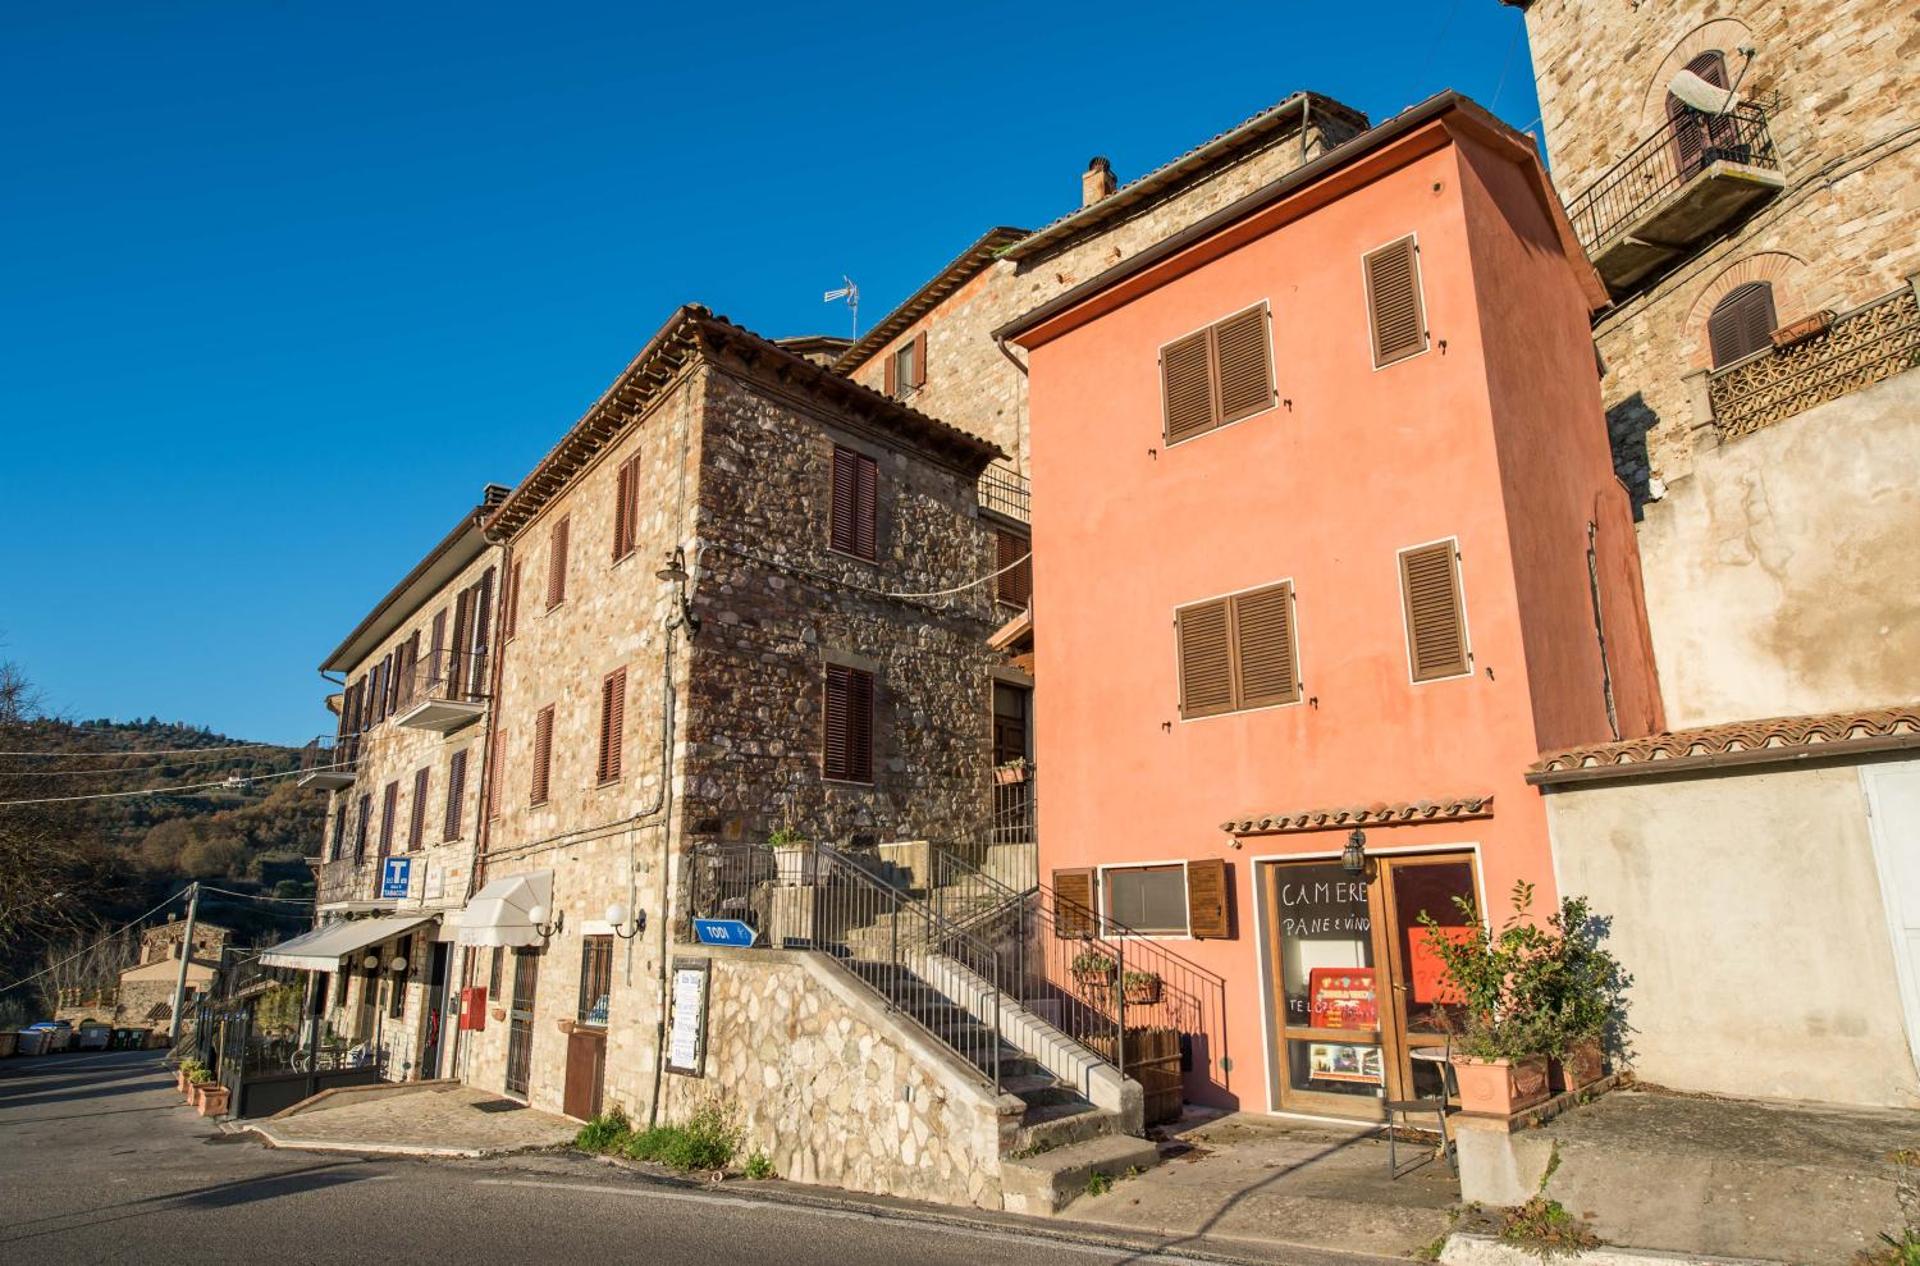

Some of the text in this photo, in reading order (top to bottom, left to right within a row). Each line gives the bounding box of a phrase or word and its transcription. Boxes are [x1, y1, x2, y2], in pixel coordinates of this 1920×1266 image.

[390, 861, 407, 884] T
[1282, 882, 1368, 906] CAMERE
[706, 926, 730, 939] TODI
[1282, 917, 1330, 936] PANE
